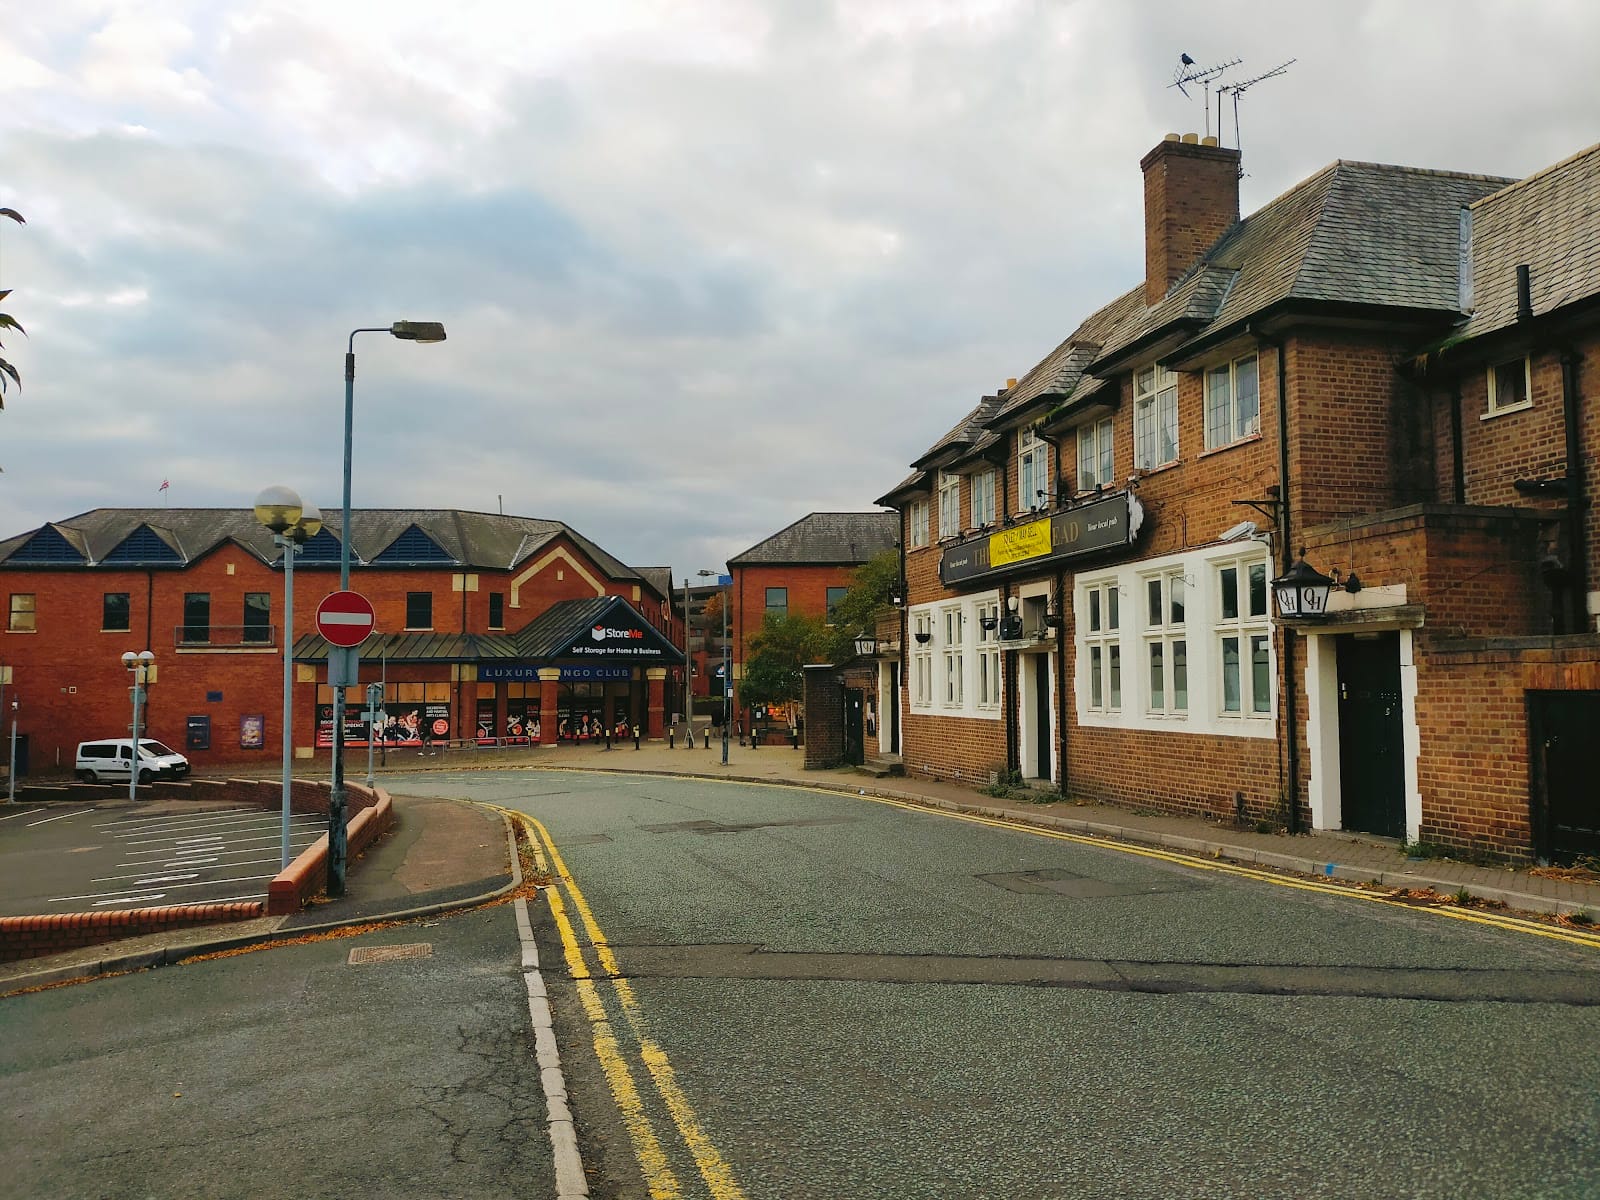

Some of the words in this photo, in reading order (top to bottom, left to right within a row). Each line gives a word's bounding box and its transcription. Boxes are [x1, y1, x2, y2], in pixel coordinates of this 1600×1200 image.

[1098, 517, 1109, 529] local
[1109, 515, 1118, 529] pub
[1052, 521, 1079, 547] EAD
[606, 628, 643, 639] StoreMe
[572, 646, 583, 654] Self
[584, 647, 606, 655] Storage
[485, 669, 538, 677] LUXUR
[563, 669, 591, 677] NGO
[596, 669, 629, 677] CLUB
